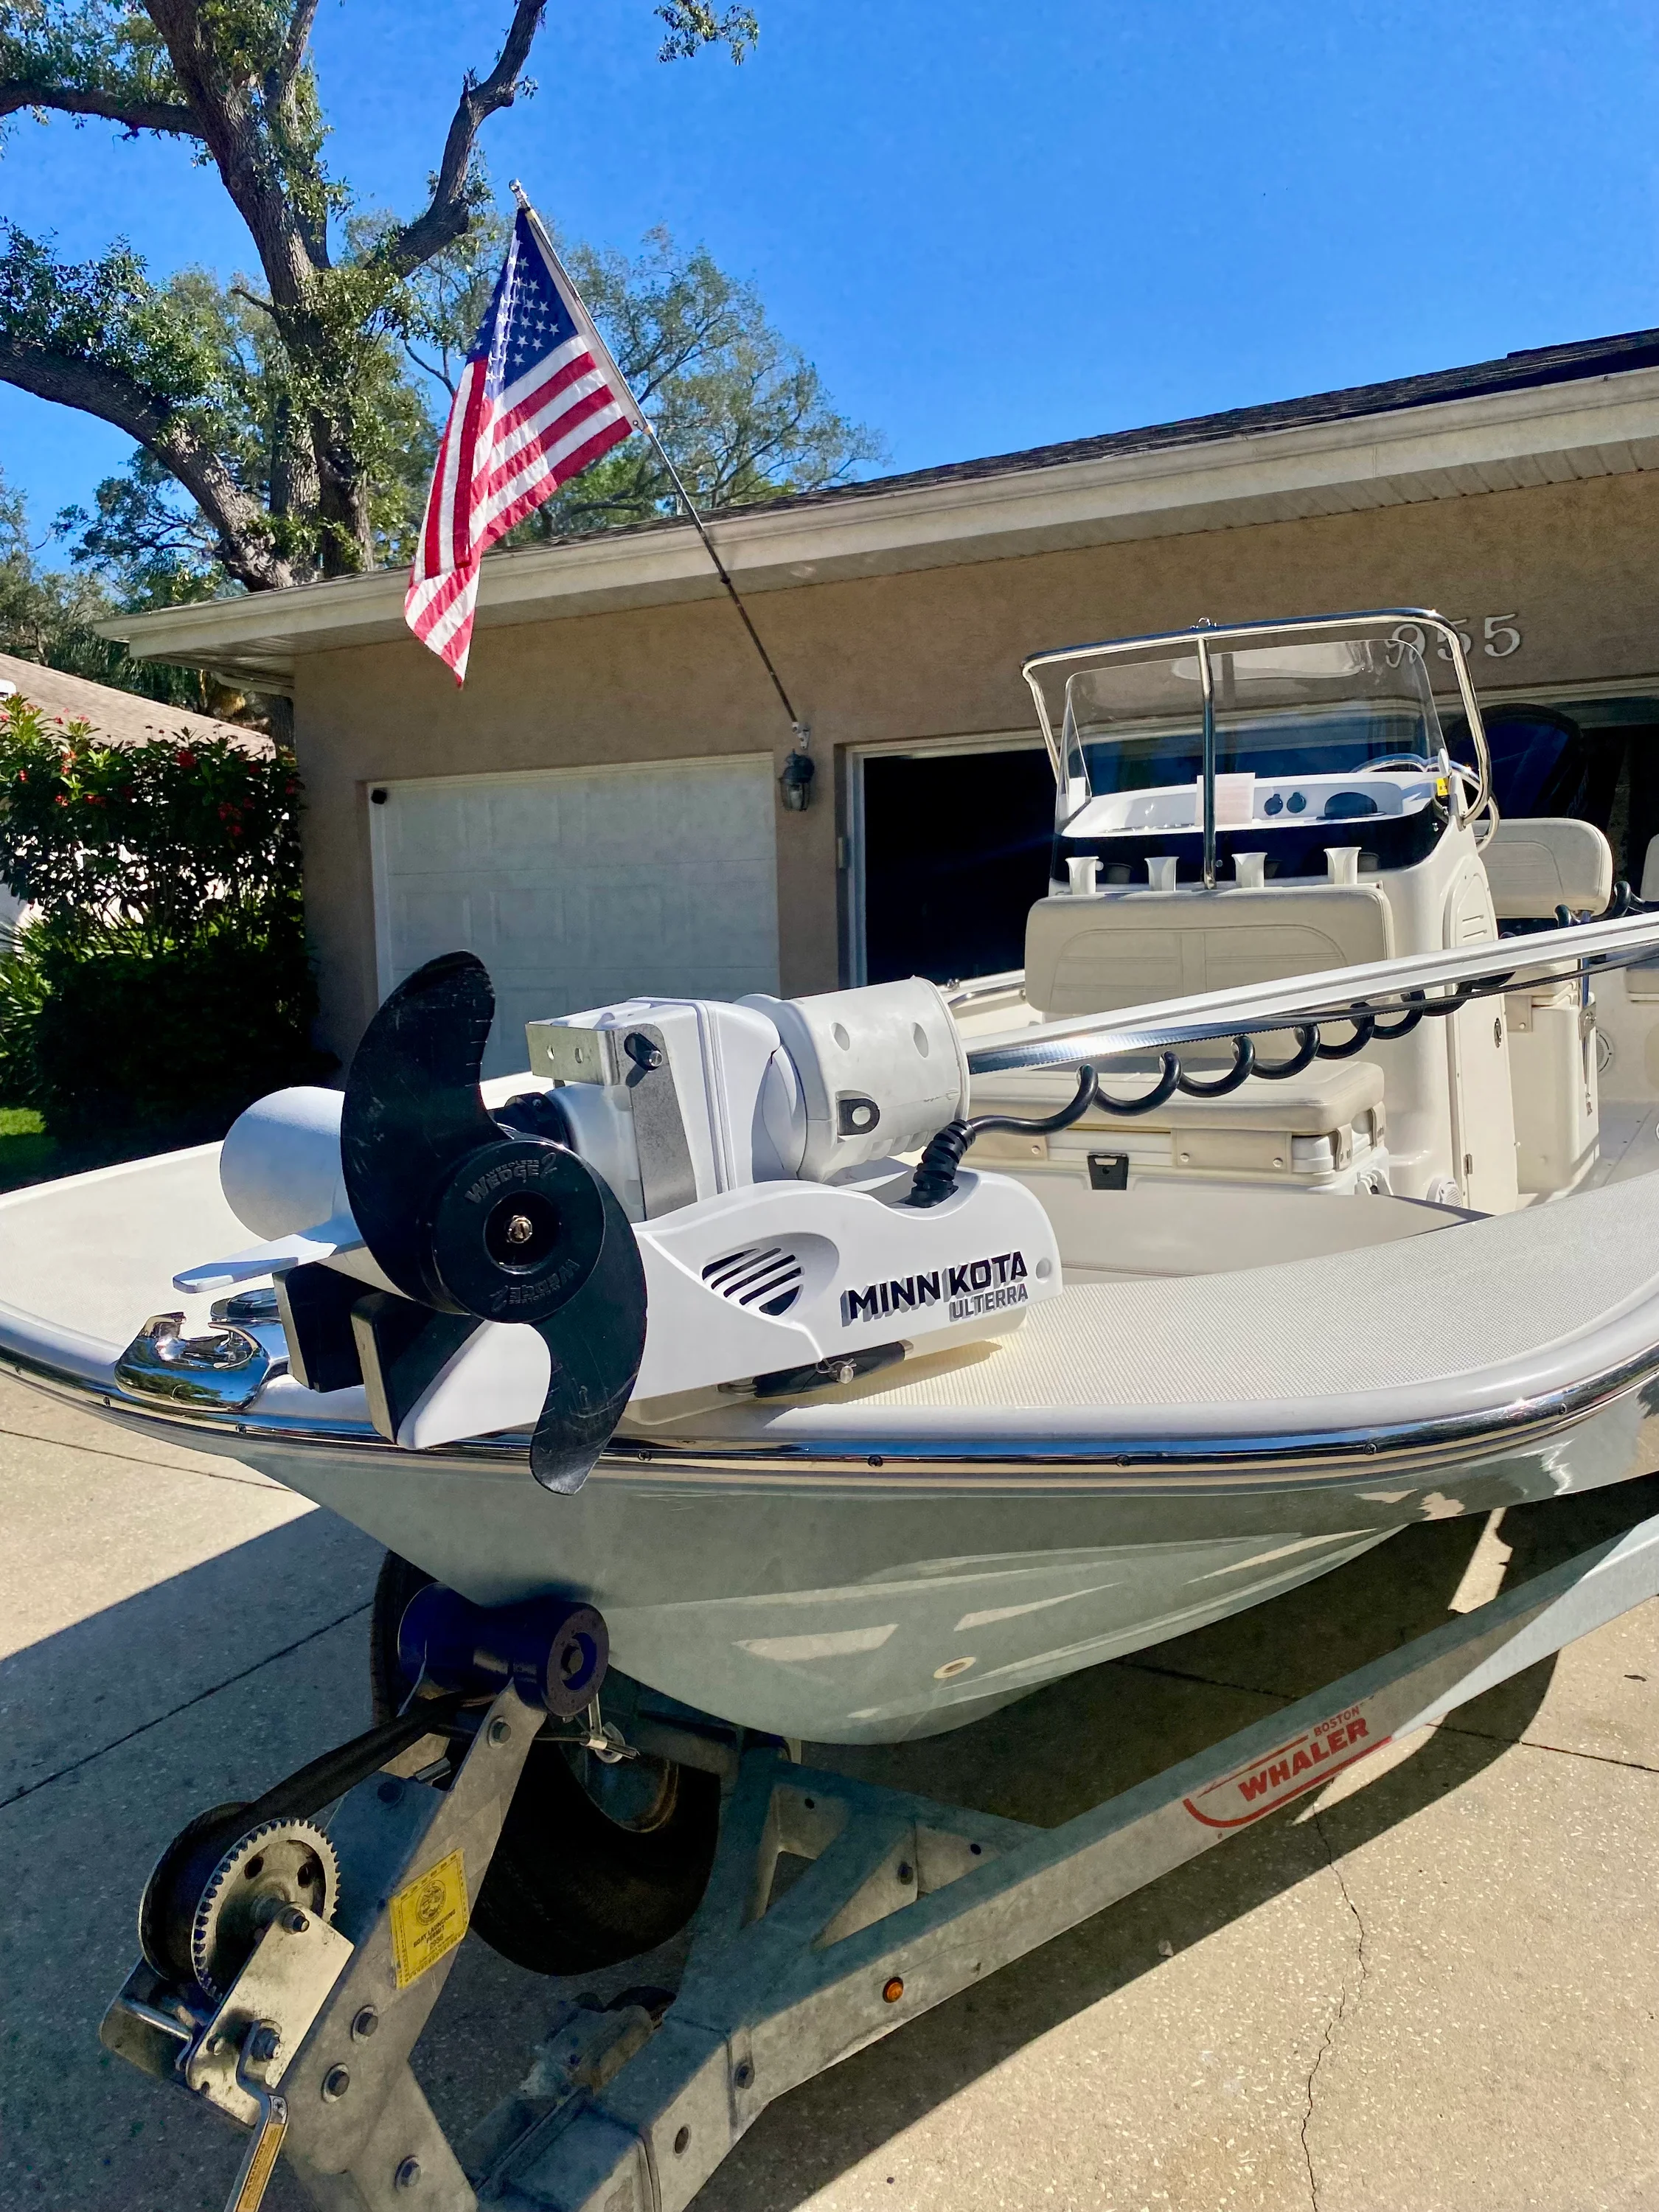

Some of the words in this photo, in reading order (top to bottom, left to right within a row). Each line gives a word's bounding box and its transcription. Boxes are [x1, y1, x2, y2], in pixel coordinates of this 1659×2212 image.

[464, 1164, 540, 1204] WEDGE
[540, 1152, 557, 1180] 2
[509, 1258, 580, 1299] WEDGE
[842, 1270, 941, 1324] MINN
[945, 1251, 1028, 1299] KOTA
[950, 1283, 1029, 1321] ULTERRA
[1313, 1705, 1360, 1737] BOSTON
[1237, 1717, 1370, 1802] WHALER
[413, 1933, 428, 1948] BOAT
[428, 1908, 456, 1935] LAUNCHING
[426, 1924, 444, 1944] PERMIT
